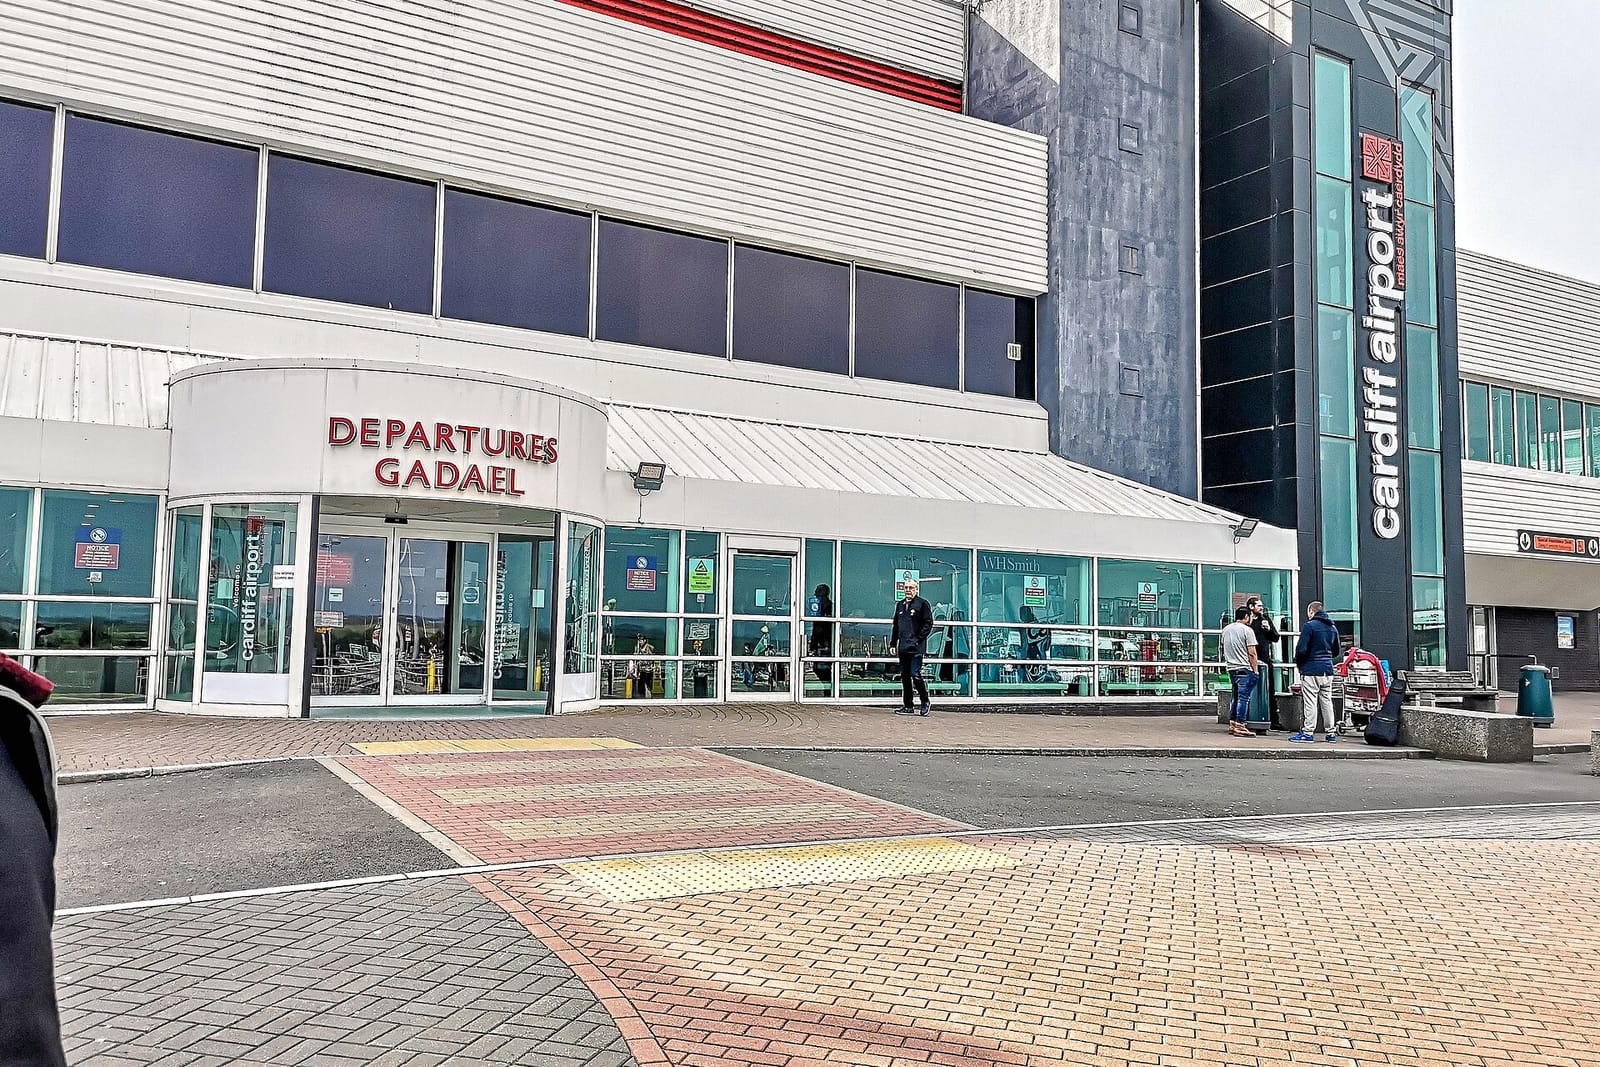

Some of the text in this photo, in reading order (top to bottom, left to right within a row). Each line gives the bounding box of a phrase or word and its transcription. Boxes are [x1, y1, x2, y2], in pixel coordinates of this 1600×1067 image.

[1392, 142, 1405, 286] maes awyr caerdydd
[1361, 188, 1405, 540] cardiff airport
[328, 417, 559, 465] DEPARTURES
[375, 458, 526, 497] GADAEL
[241, 535, 262, 661] cardiff airport
[983, 556, 1040, 572] WHSmith
